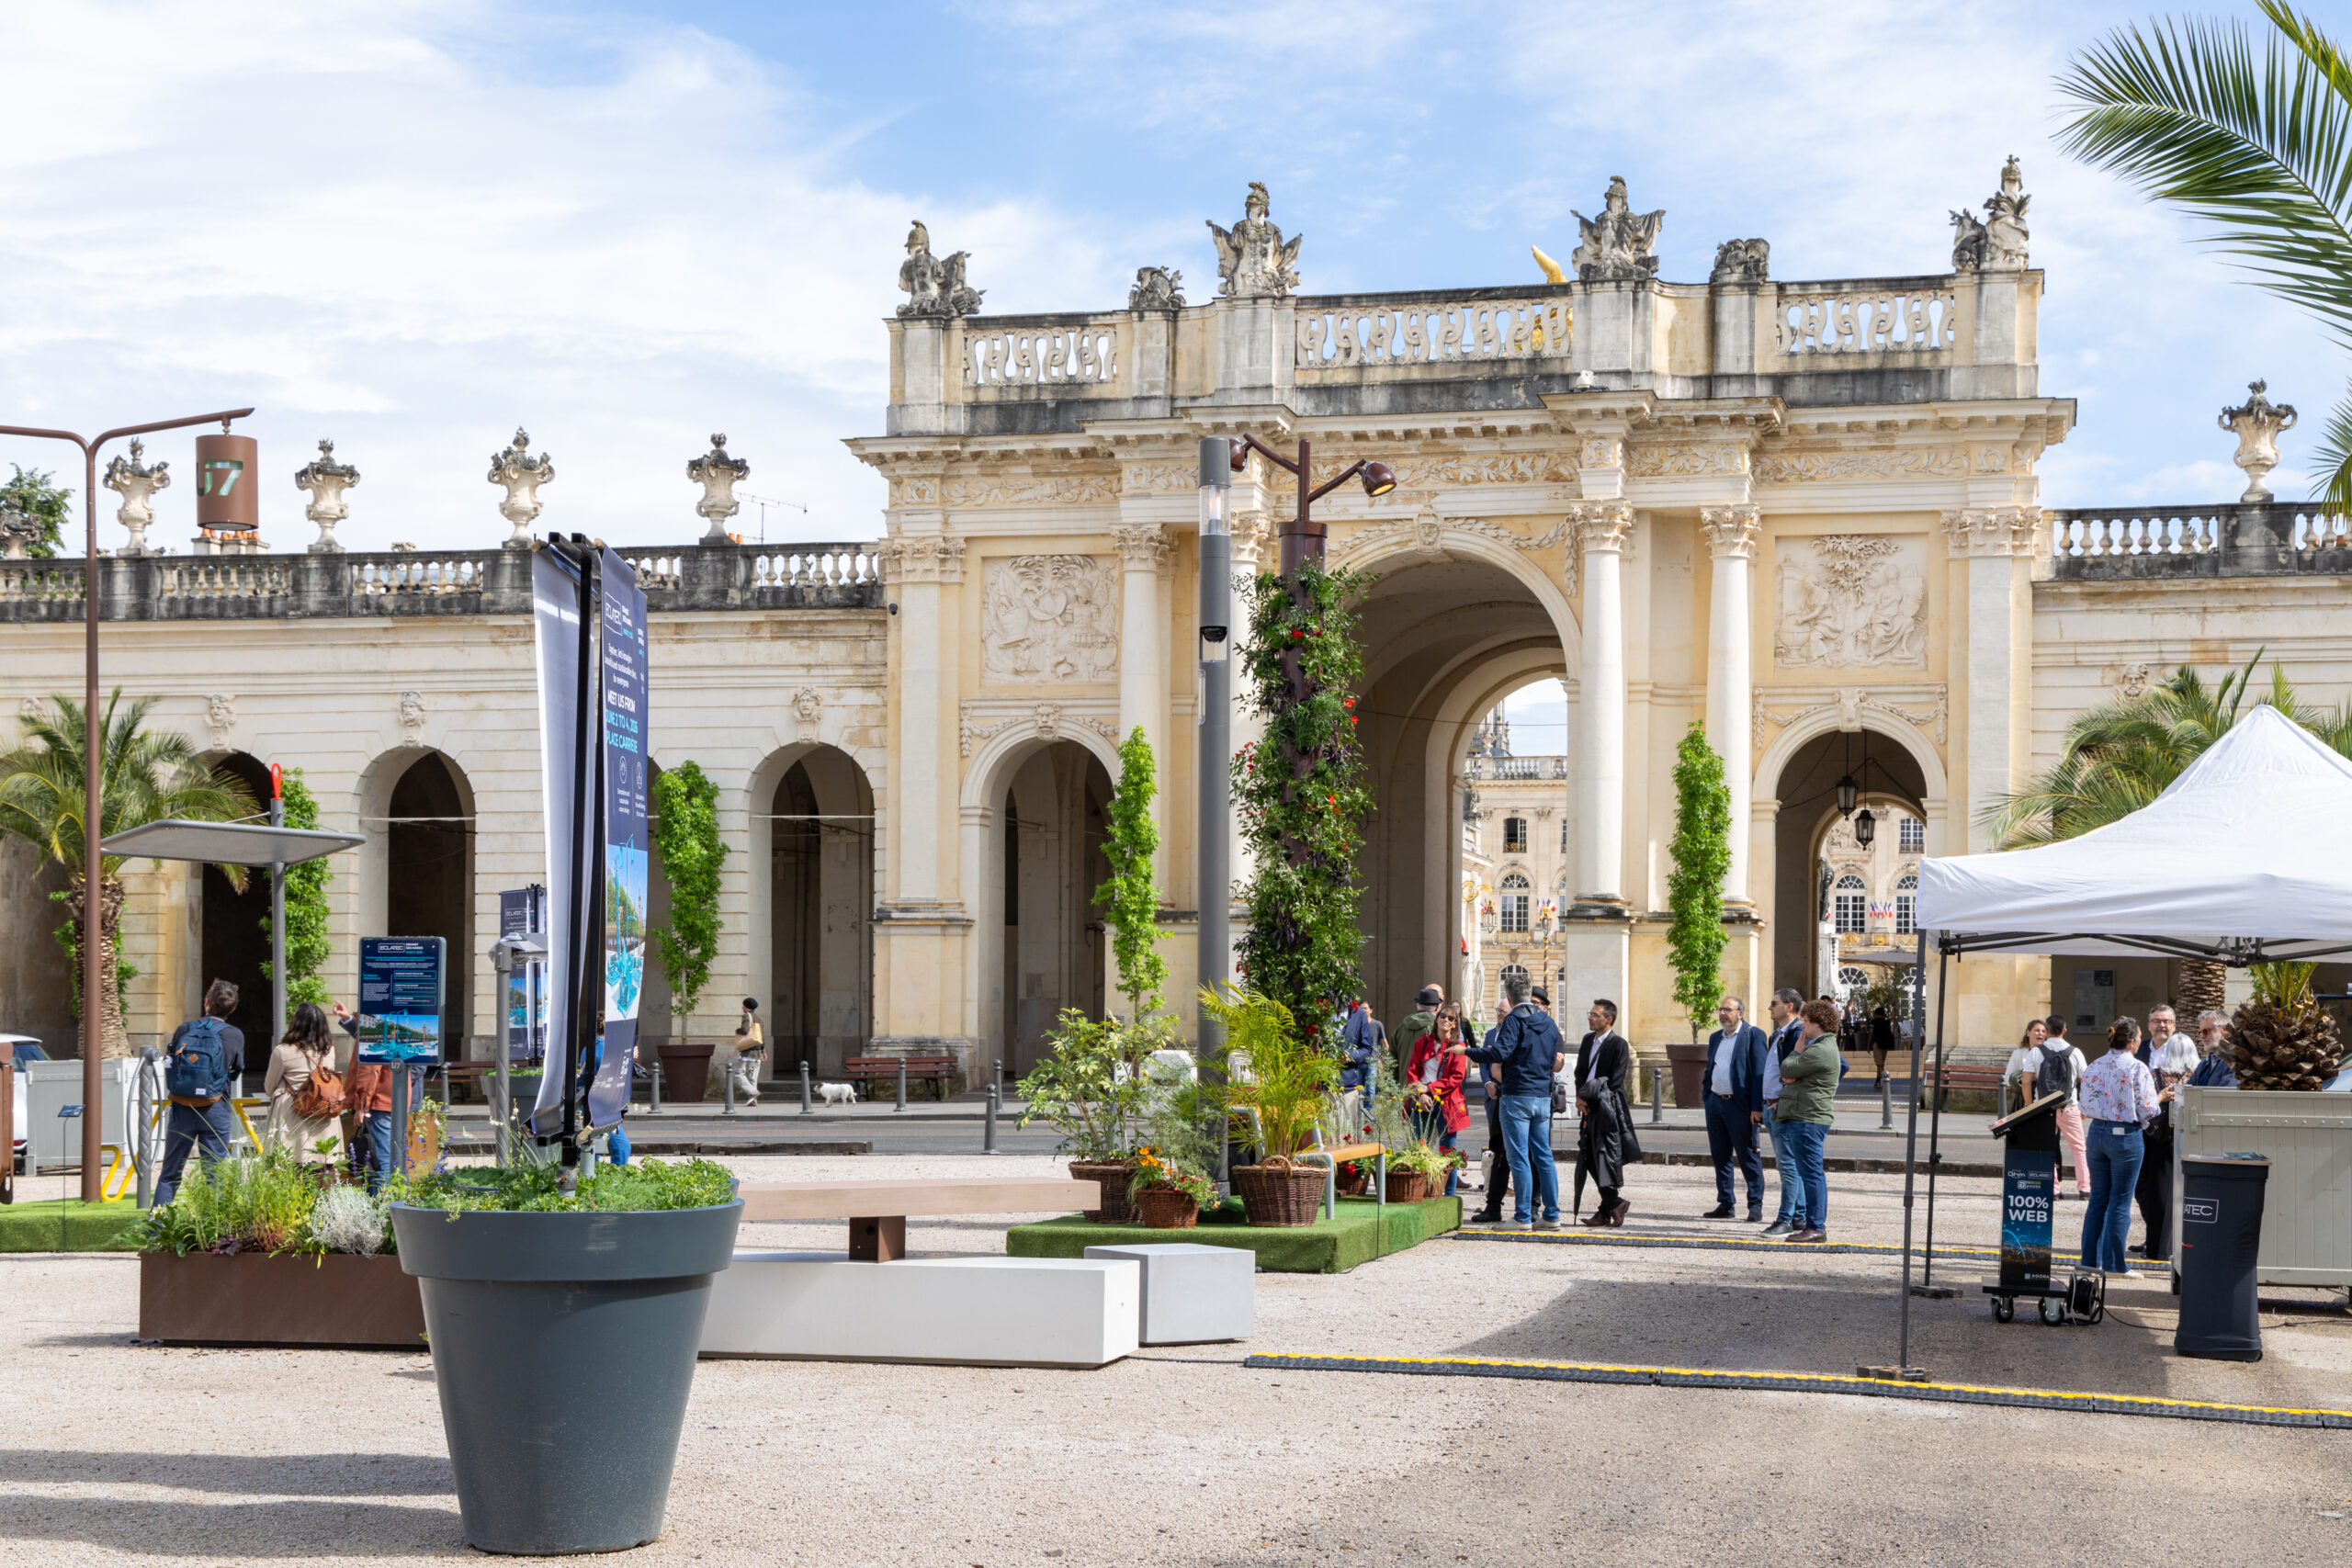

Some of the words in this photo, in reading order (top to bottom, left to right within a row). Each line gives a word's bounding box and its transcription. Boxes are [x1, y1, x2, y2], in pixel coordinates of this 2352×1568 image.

[608, 689, 616, 705] MEET
[618, 694, 624, 708] US
[618, 714, 625, 728] TO
[2007, 1195, 2049, 1209] 100%
[2008, 1209, 2048, 1223] WEB
[2183, 1203, 2213, 1216] ATEC
